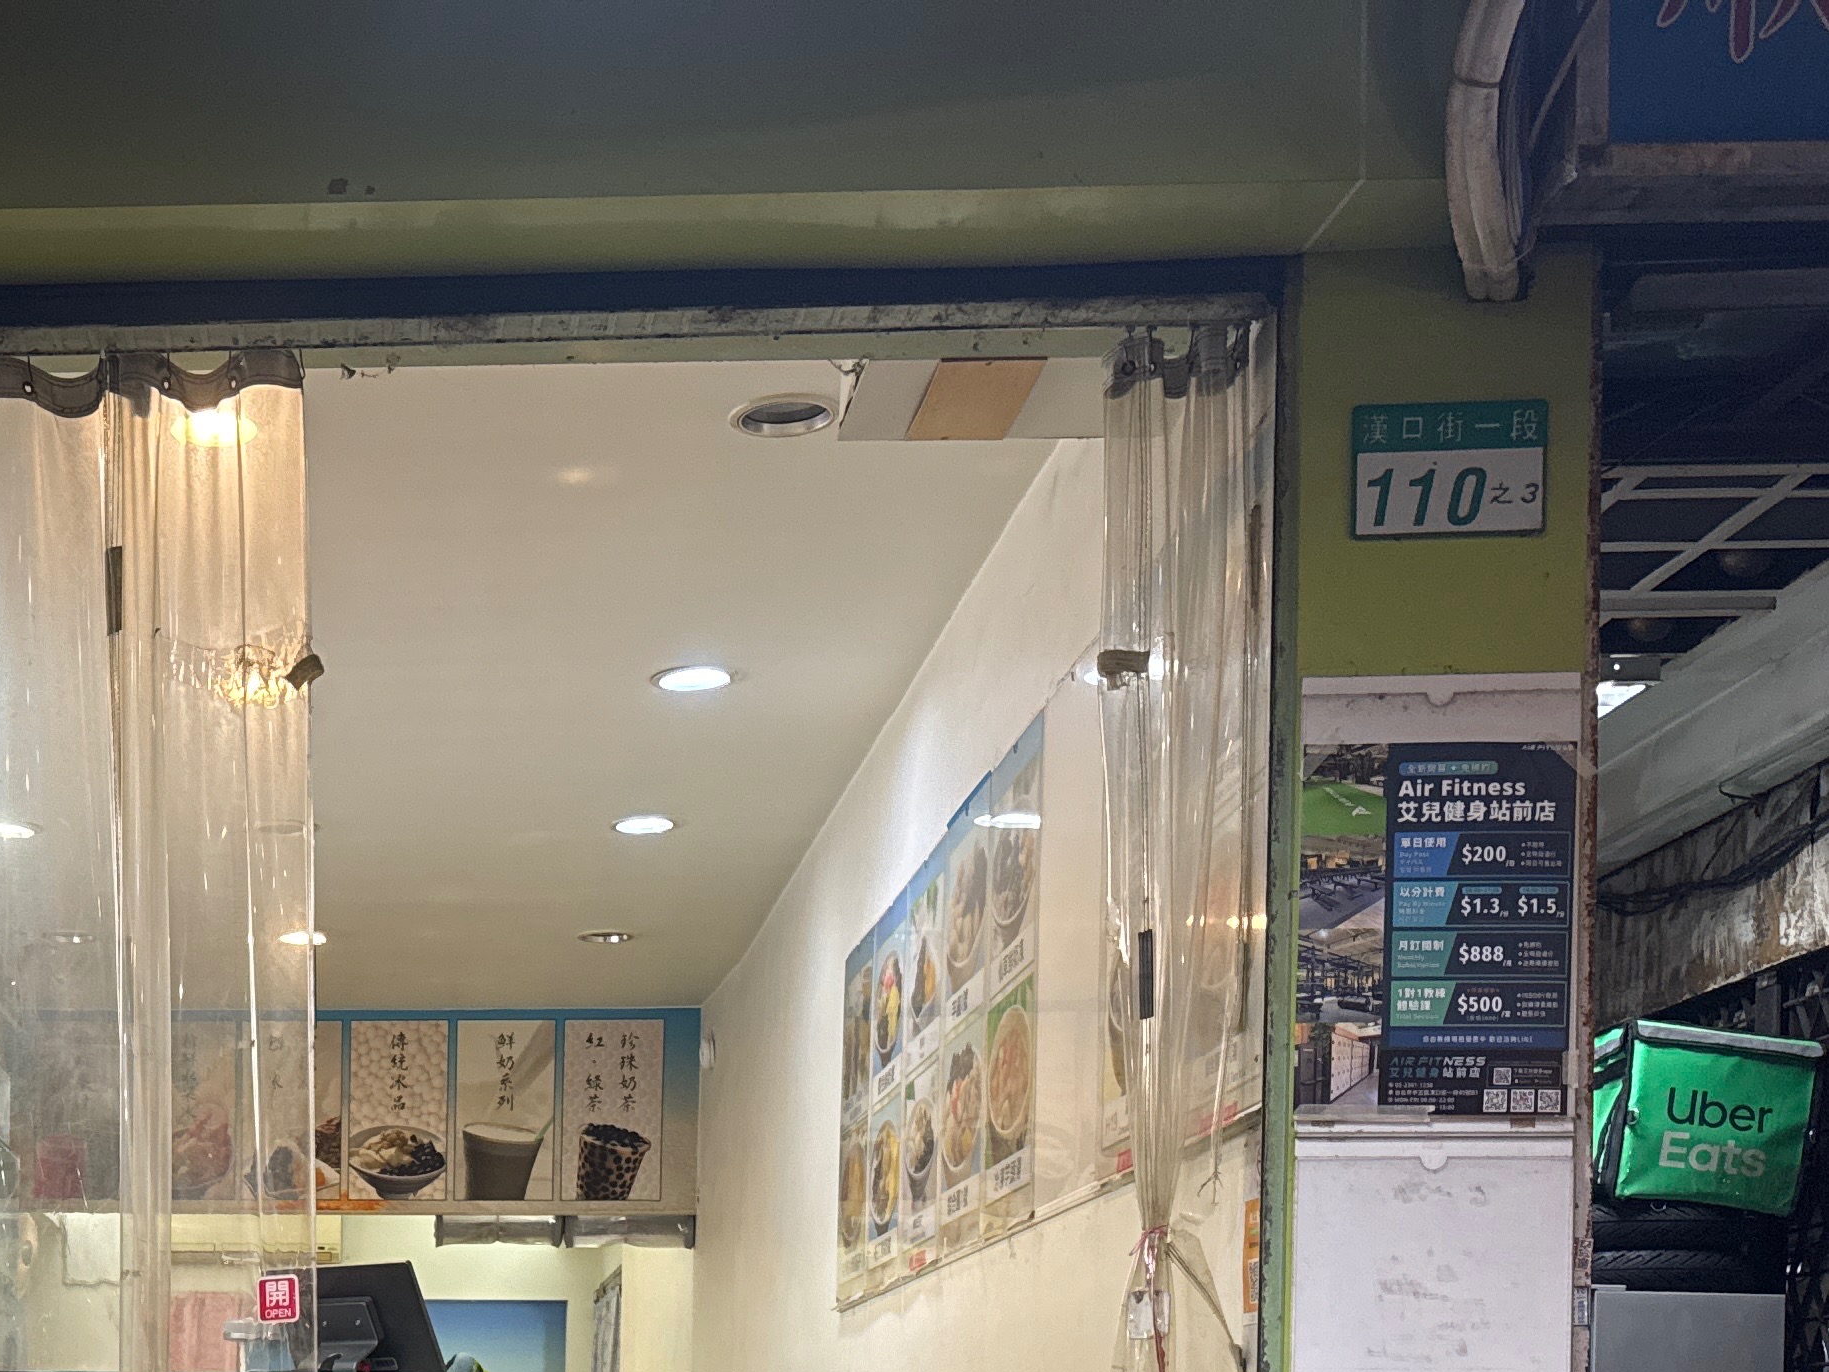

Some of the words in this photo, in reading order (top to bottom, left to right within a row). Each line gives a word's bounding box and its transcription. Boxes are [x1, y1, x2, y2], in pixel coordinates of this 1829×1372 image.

[1363, 409, 1539, 444] 漢口街一段
[1367, 467, 1487, 526] 110
[1398, 779, 1434, 797] Air
[1441, 778, 1526, 797] Fitness
[1397, 800, 1557, 822] 艾兒健身站前店
[389, 1032, 409, 1112] 傳統冰品
[496, 1032, 516, 1112] 鮮奶系列
[618, 1032, 639, 1112] 珍珠奶茶
[1666, 1086, 1773, 1133] Uber
[1659, 1130, 1766, 1177] Eats
[264, 1280, 290, 1308] 開
[264, 1308, 292, 1319] OPEN
